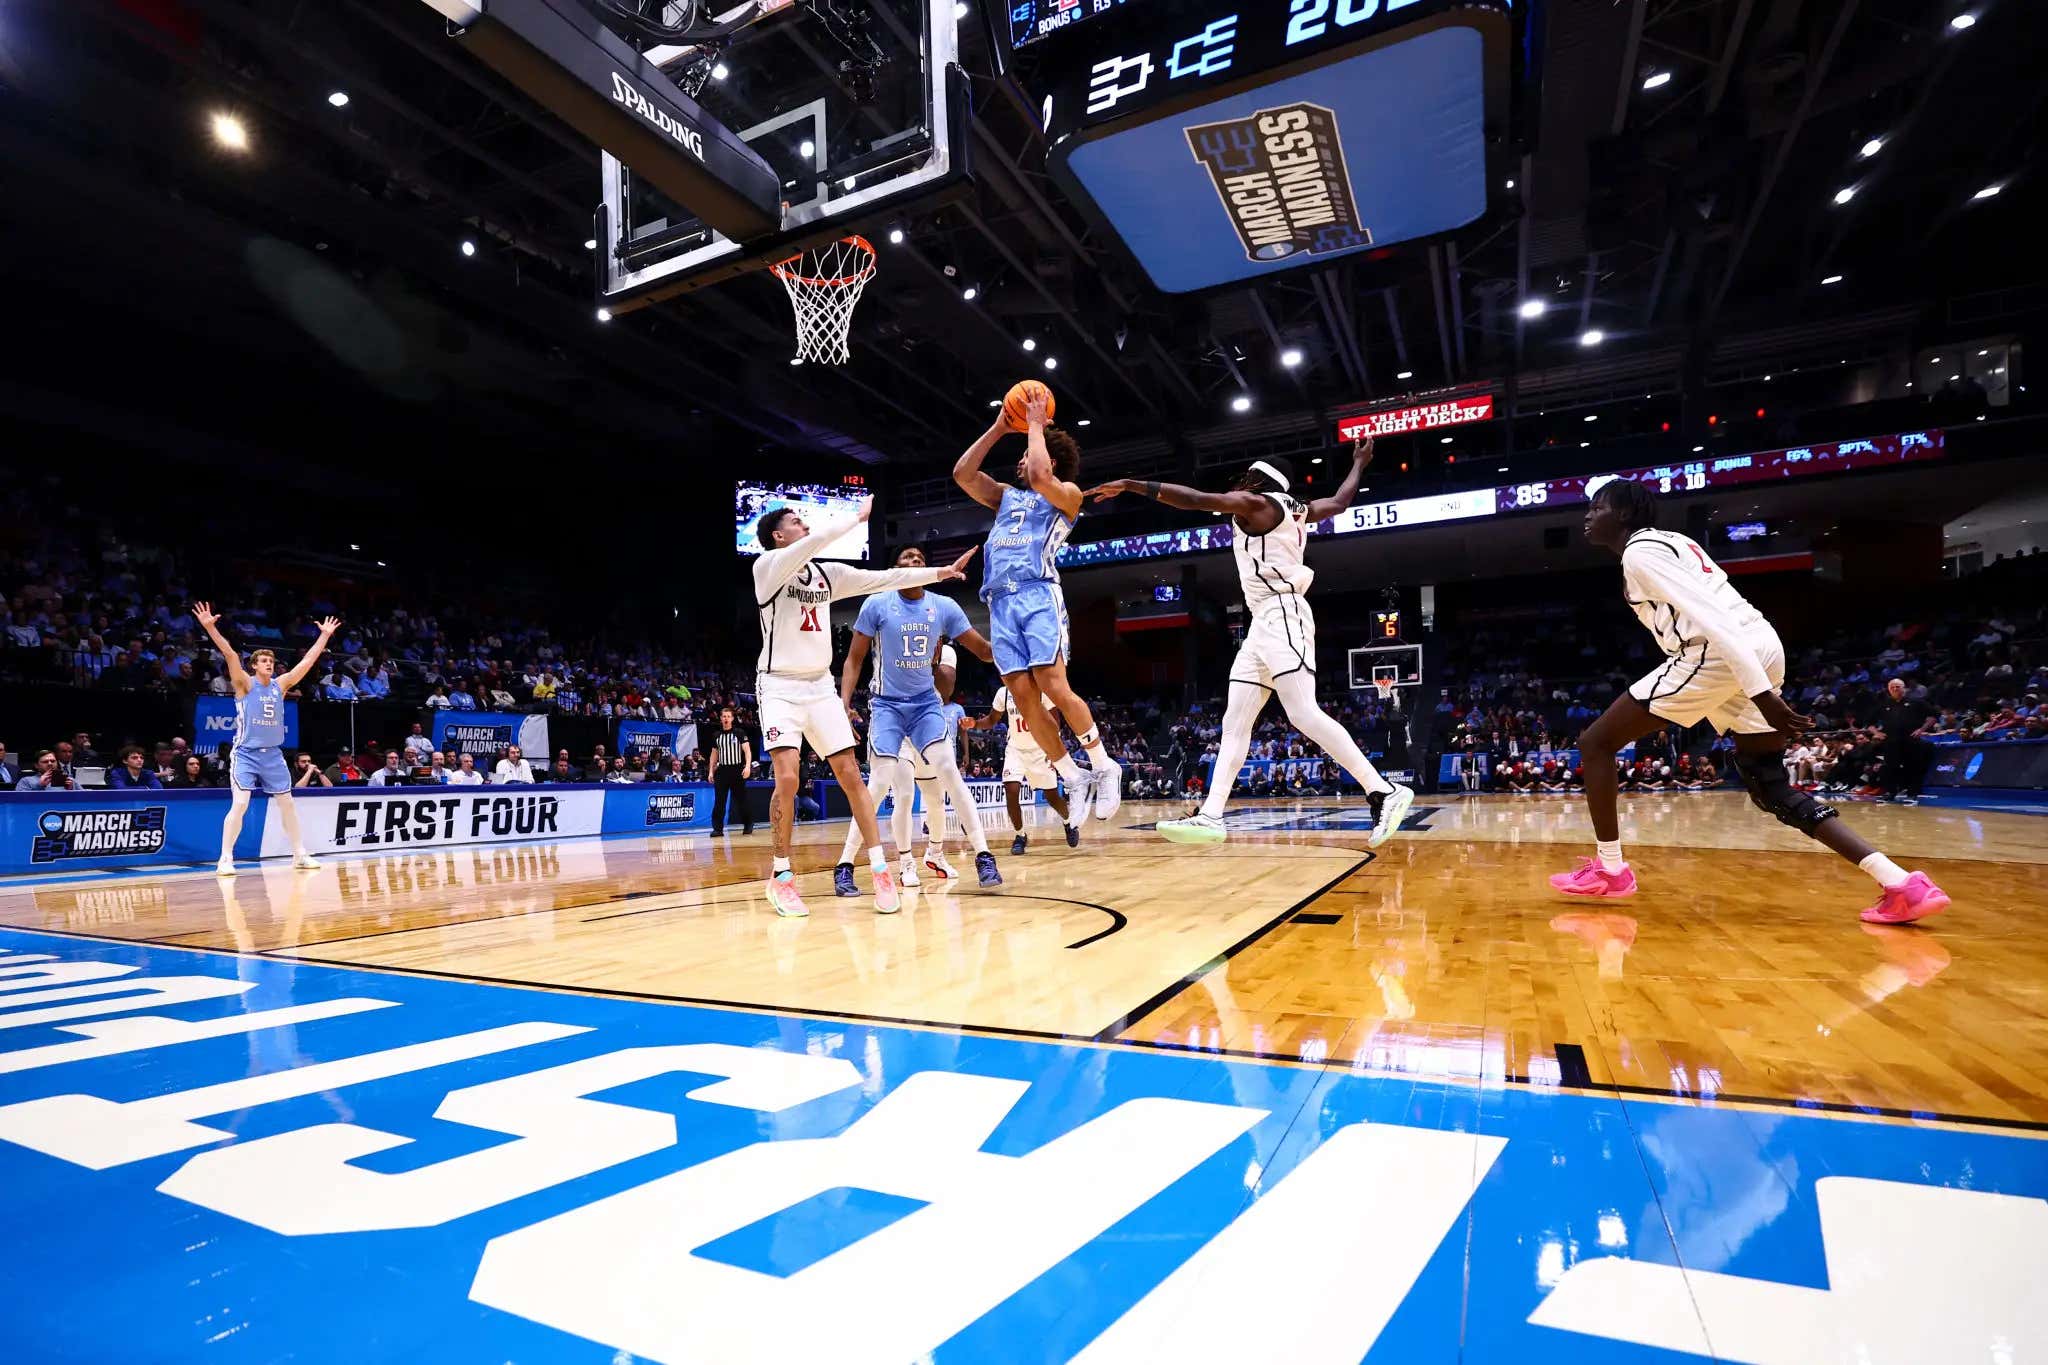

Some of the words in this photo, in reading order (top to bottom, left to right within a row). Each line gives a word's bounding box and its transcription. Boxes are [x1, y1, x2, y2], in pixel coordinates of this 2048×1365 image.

[1038, 10, 1071, 34] BONUS
[612, 71, 704, 161] SPALDING
[1258, 110, 1336, 228] MADNESS
[1224, 171, 1293, 245] MARCH
[1352, 416, 1421, 438] FLIGHT
[1425, 405, 1479, 427] DECK
[1370, 412, 1396, 424] THE
[1402, 403, 1458, 419] CONNOR
[1838, 440, 1873, 454] 3PT%
[1901, 433, 1928, 446] FT%
[1684, 463, 1705, 474] FLS
[1714, 457, 1752, 471] BONUS
[1659, 477, 1671, 493] 3
[1685, 473, 1705, 490] 10
[1516, 483, 1547, 506] 85
[1010, 511, 1026, 534] 7
[1354, 504, 1398, 528] 5:15
[815, 591, 829, 604] STATE
[800, 606, 822, 631] 21
[901, 623, 930, 632] NORTH
[1386, 621, 1396, 636] 6
[902, 635, 929, 658] 13
[263, 704, 275, 718] 5
[456, 727, 494, 740] MARCH
[635, 734, 660, 745] MARCH
[1082, 734, 1091, 743] 7
[657, 797, 682, 808] MARCH
[660, 807, 693, 818] MADNESS
[64, 813, 132, 832] MARCH
[336, 798, 461, 846] FIRST
[471, 796, 559, 837] FOUR
[73, 830, 163, 850] MADNESS
